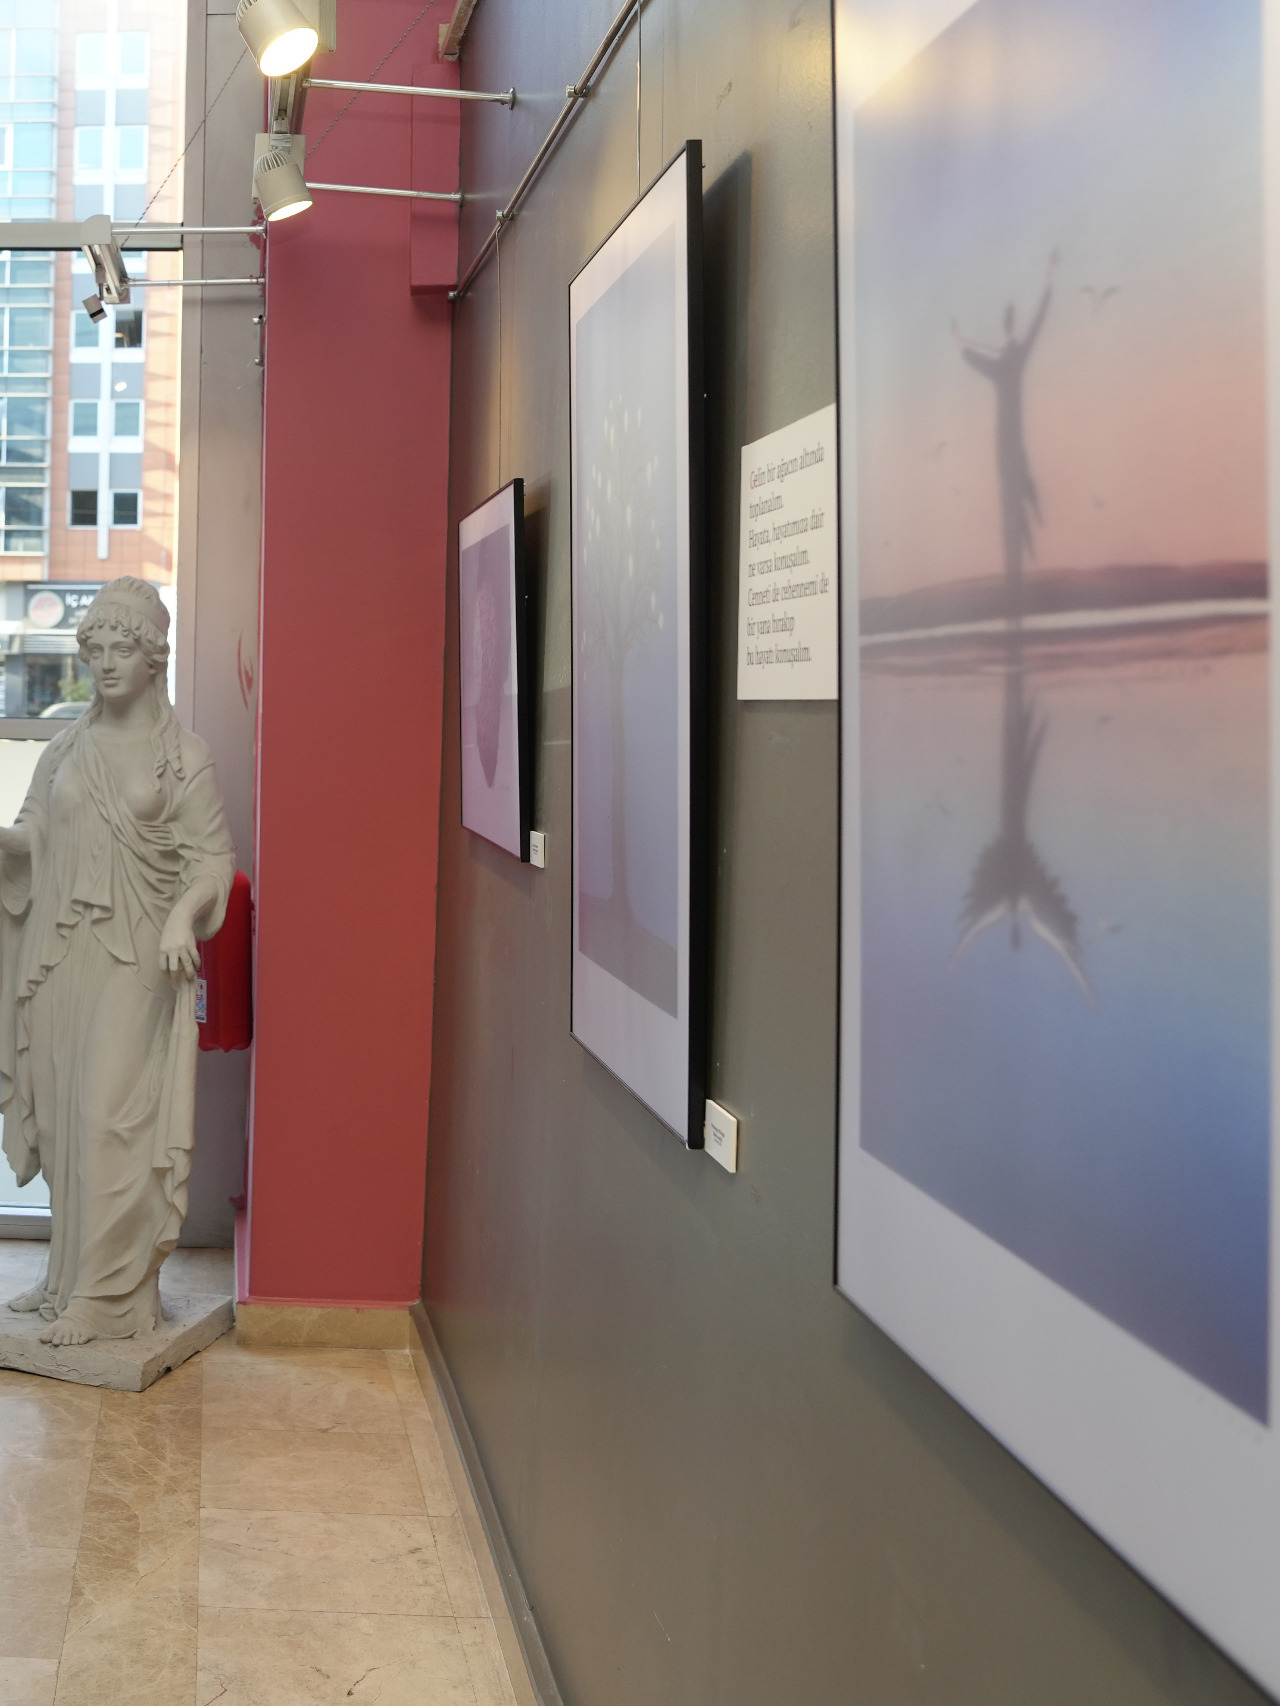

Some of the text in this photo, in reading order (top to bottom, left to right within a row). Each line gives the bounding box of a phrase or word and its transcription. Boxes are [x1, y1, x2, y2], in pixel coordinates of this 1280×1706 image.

[749, 441, 825, 490] Gelin bir ağacın altında
[771, 521, 809, 545] hayatımıza
[809, 507, 825, 531] dair
[747, 545, 811, 578] ne varsa konuşalım.
[771, 582, 780, 603] de
[819, 571, 829, 594] de
[746, 611, 795, 640] bir yana bırakıp
[746, 646, 754, 666] bu
[774, 641, 813, 670] konuşalım.
